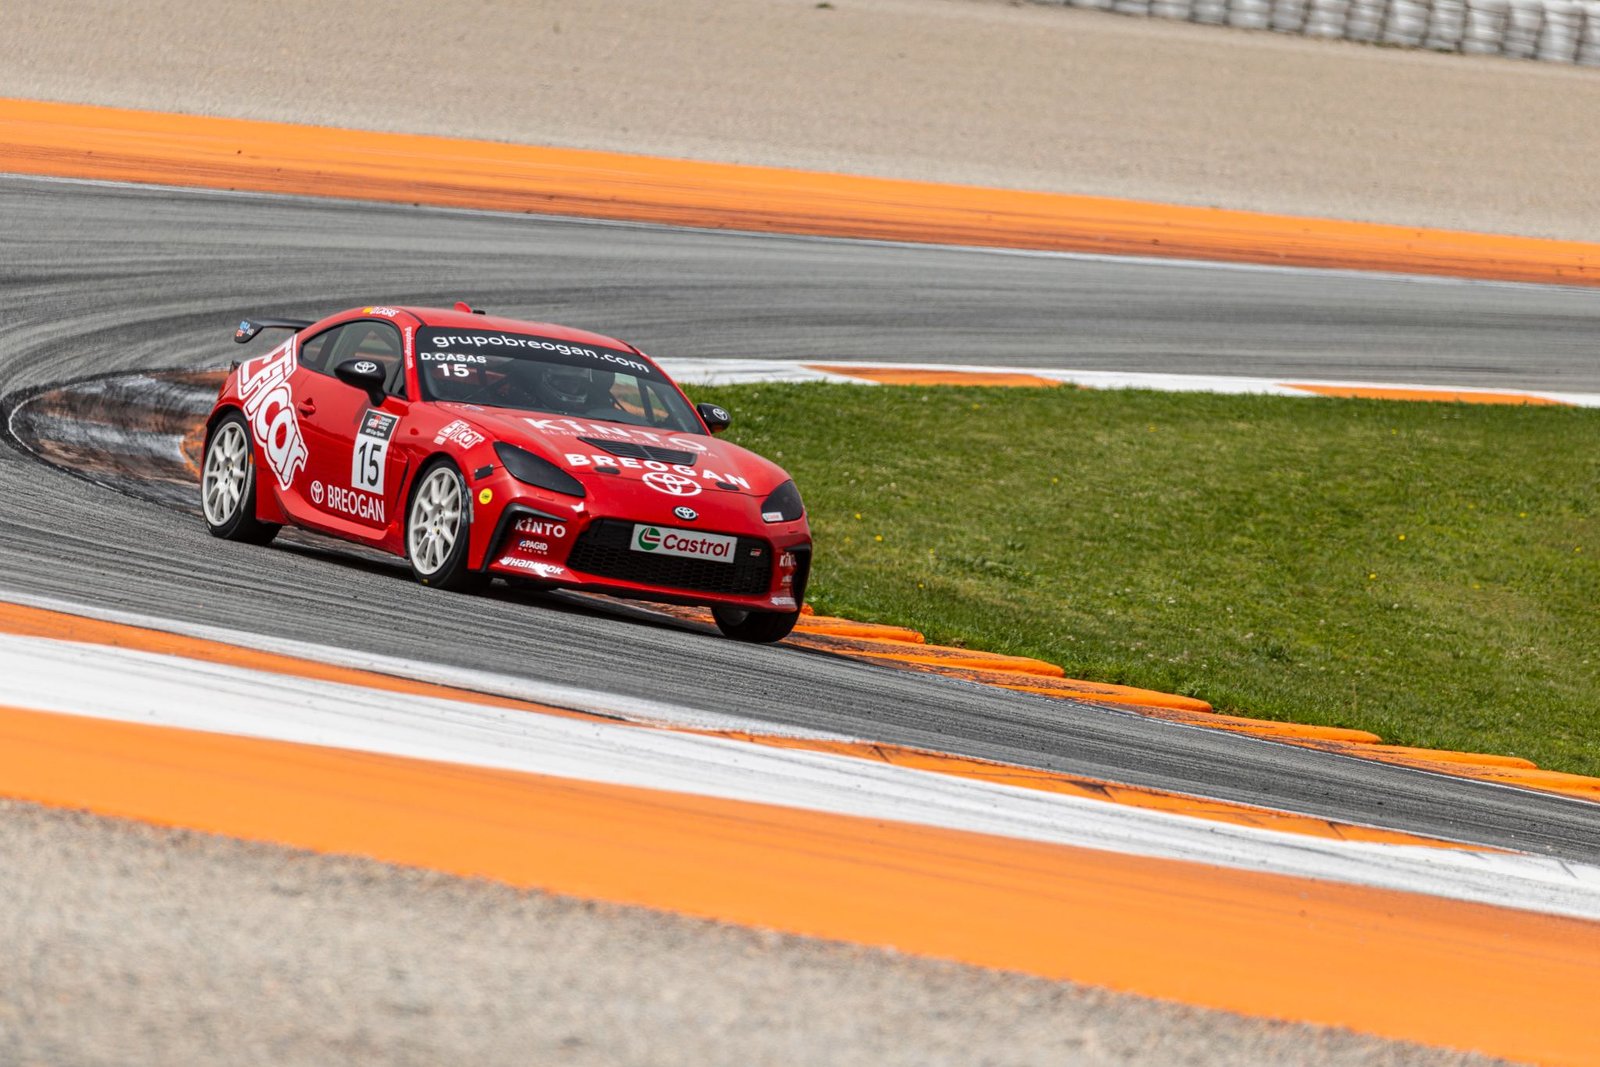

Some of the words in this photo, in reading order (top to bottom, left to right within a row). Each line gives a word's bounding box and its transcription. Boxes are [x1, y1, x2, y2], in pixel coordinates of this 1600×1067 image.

[420, 352, 487, 364] D.CASAS
[432, 335, 650, 373] grupobreogan.com
[437, 363, 470, 378] 15
[358, 441, 383, 487] 15
[564, 453, 751, 490] BREOGAN
[327, 484, 386, 523] BREOGAN
[518, 547, 548, 555] RACING
[525, 540, 548, 551] PAGID
[663, 533, 731, 557] Castrol
